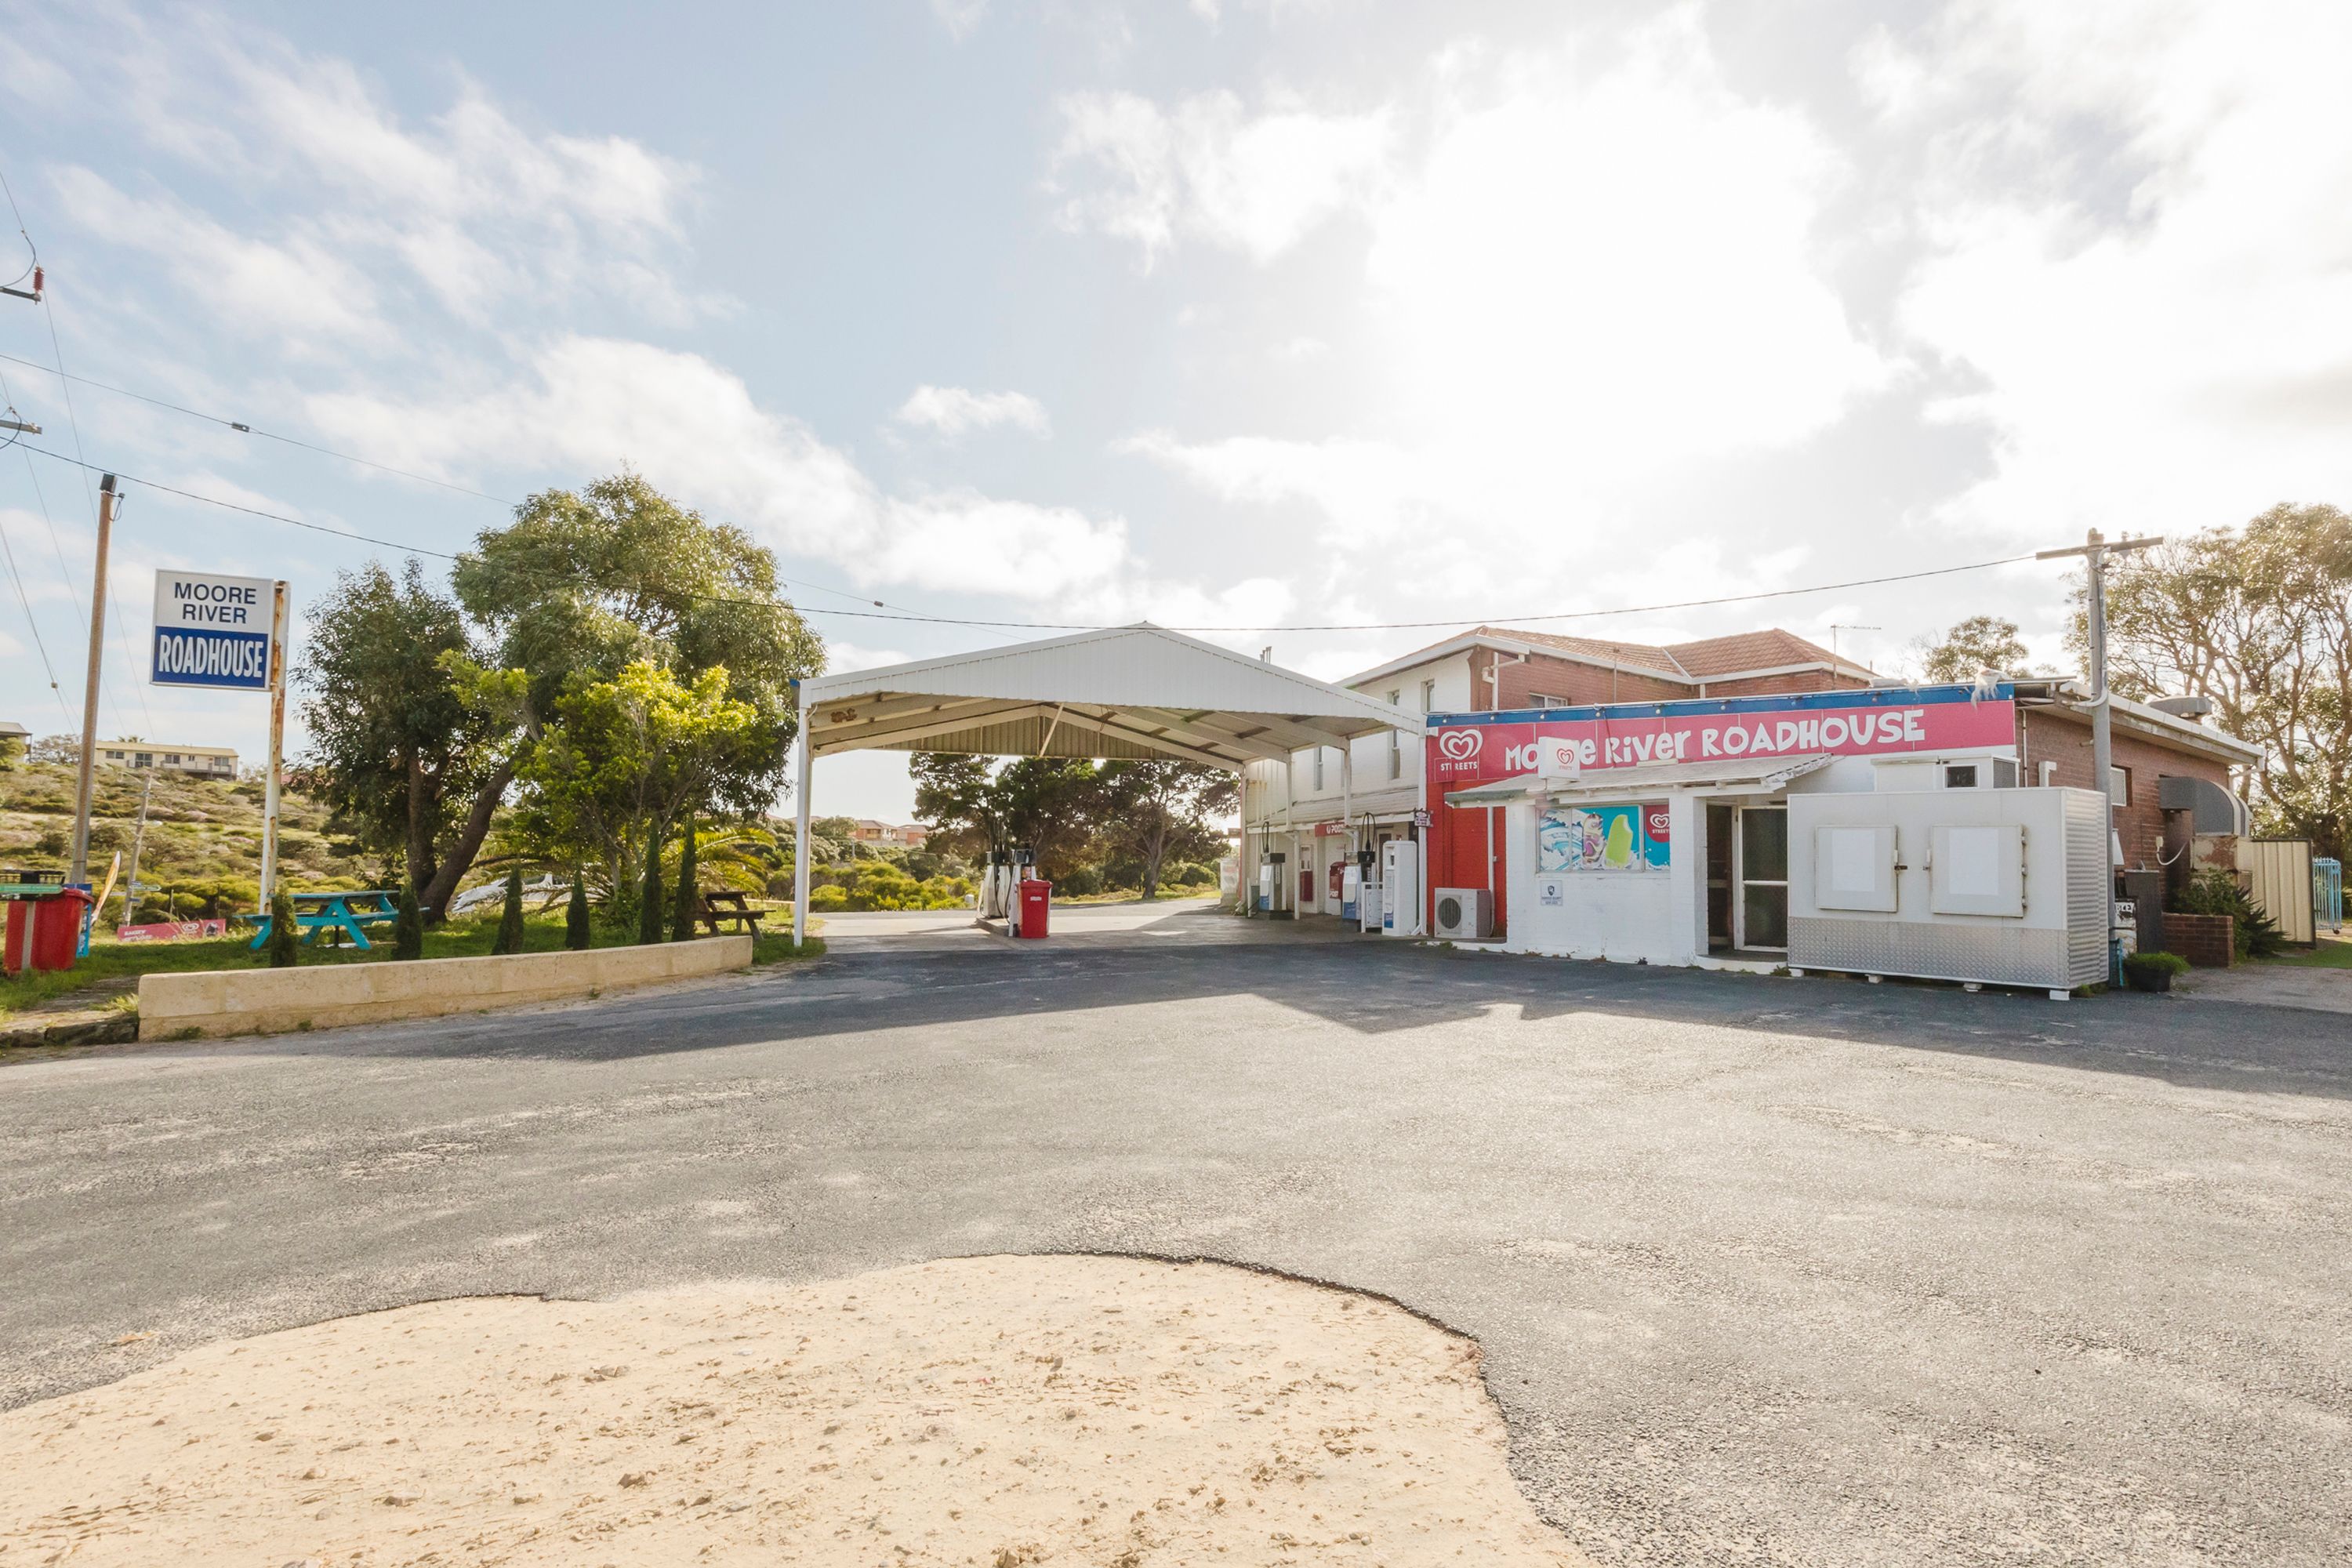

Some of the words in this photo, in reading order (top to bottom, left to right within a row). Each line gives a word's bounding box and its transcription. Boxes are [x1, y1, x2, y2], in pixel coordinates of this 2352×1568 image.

[174, 582, 256, 604] MOORE
[182, 603, 247, 624] RIVER
[158, 634, 264, 678] ROADHOUSE
[1702, 709, 1926, 757] ROADHOUSE
